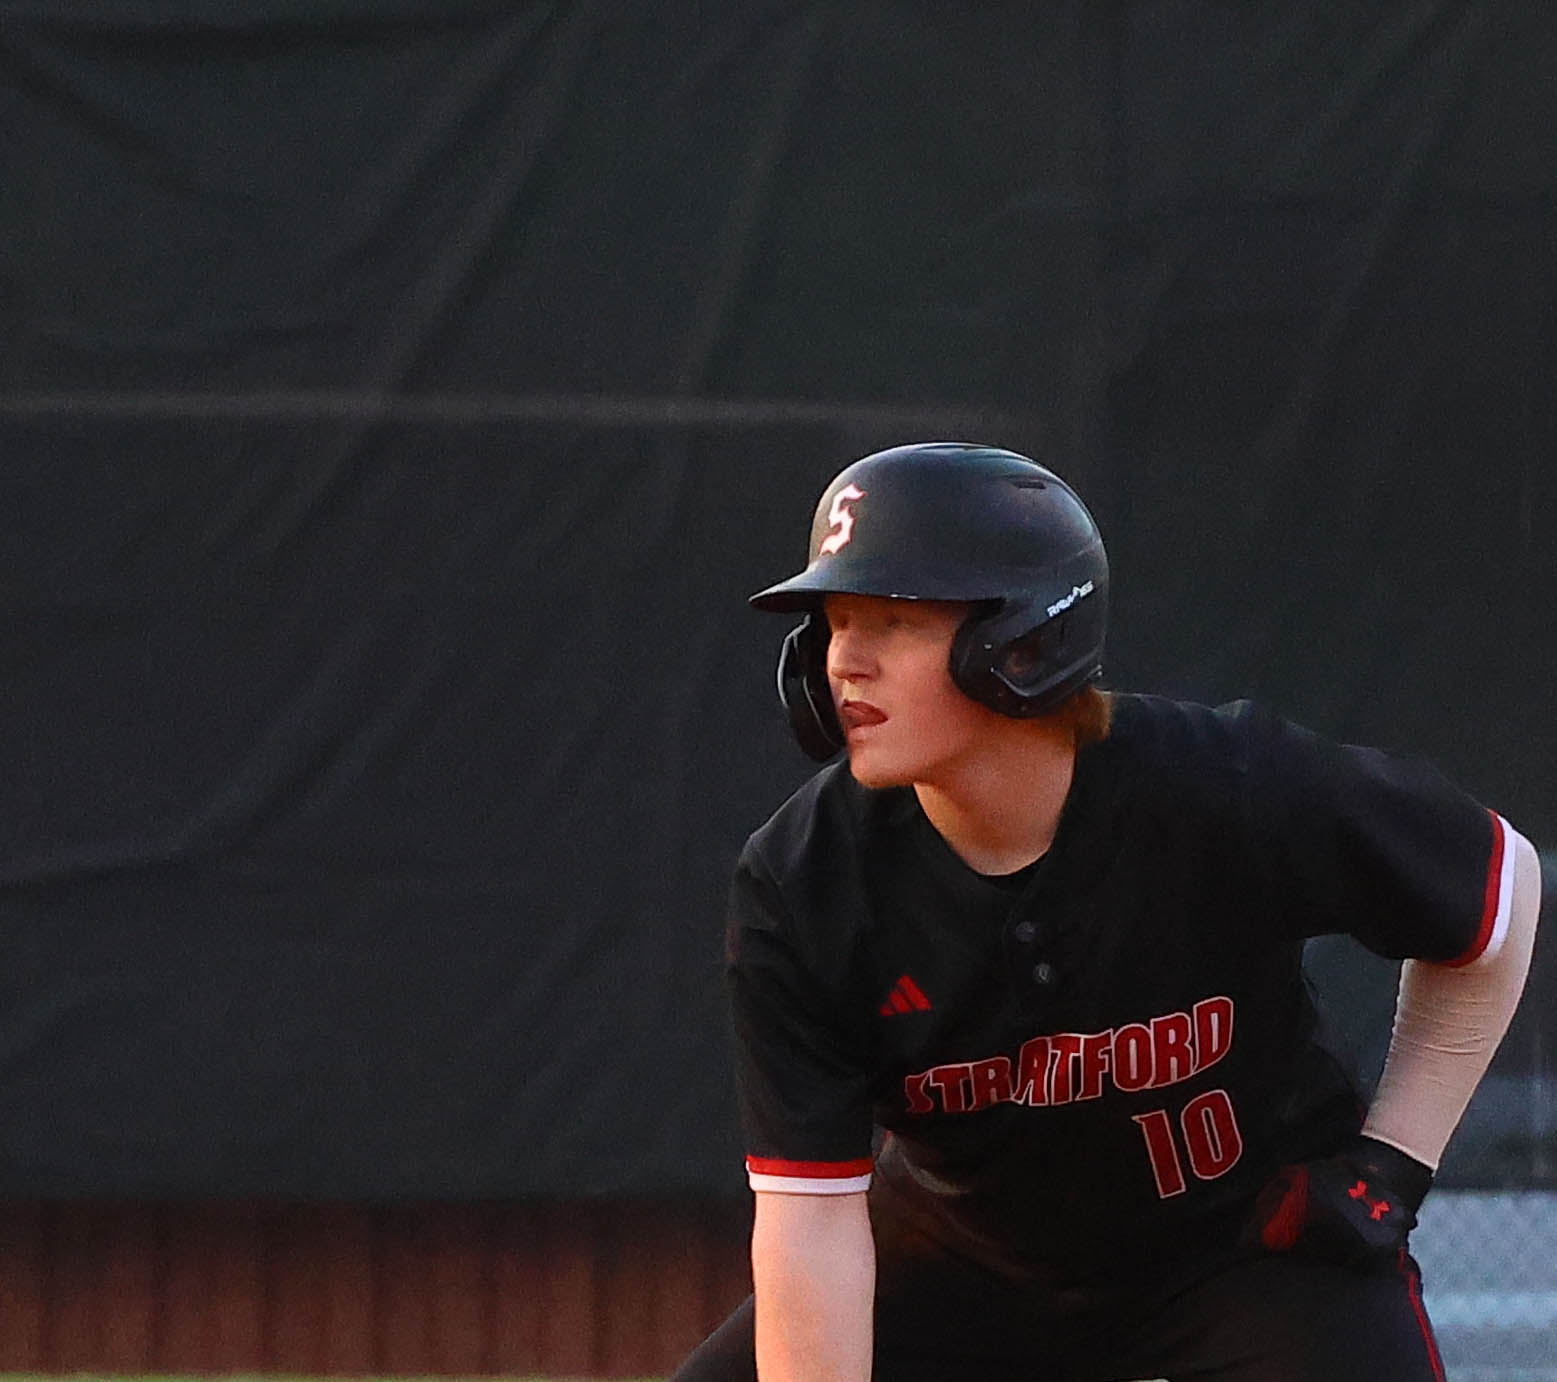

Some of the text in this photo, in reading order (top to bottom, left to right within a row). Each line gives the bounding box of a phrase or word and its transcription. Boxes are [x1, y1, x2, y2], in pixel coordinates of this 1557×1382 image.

[818, 483, 868, 556] S
[904, 996, 1233, 1113] STRATFORD
[1131, 1089, 1242, 1199] 10
